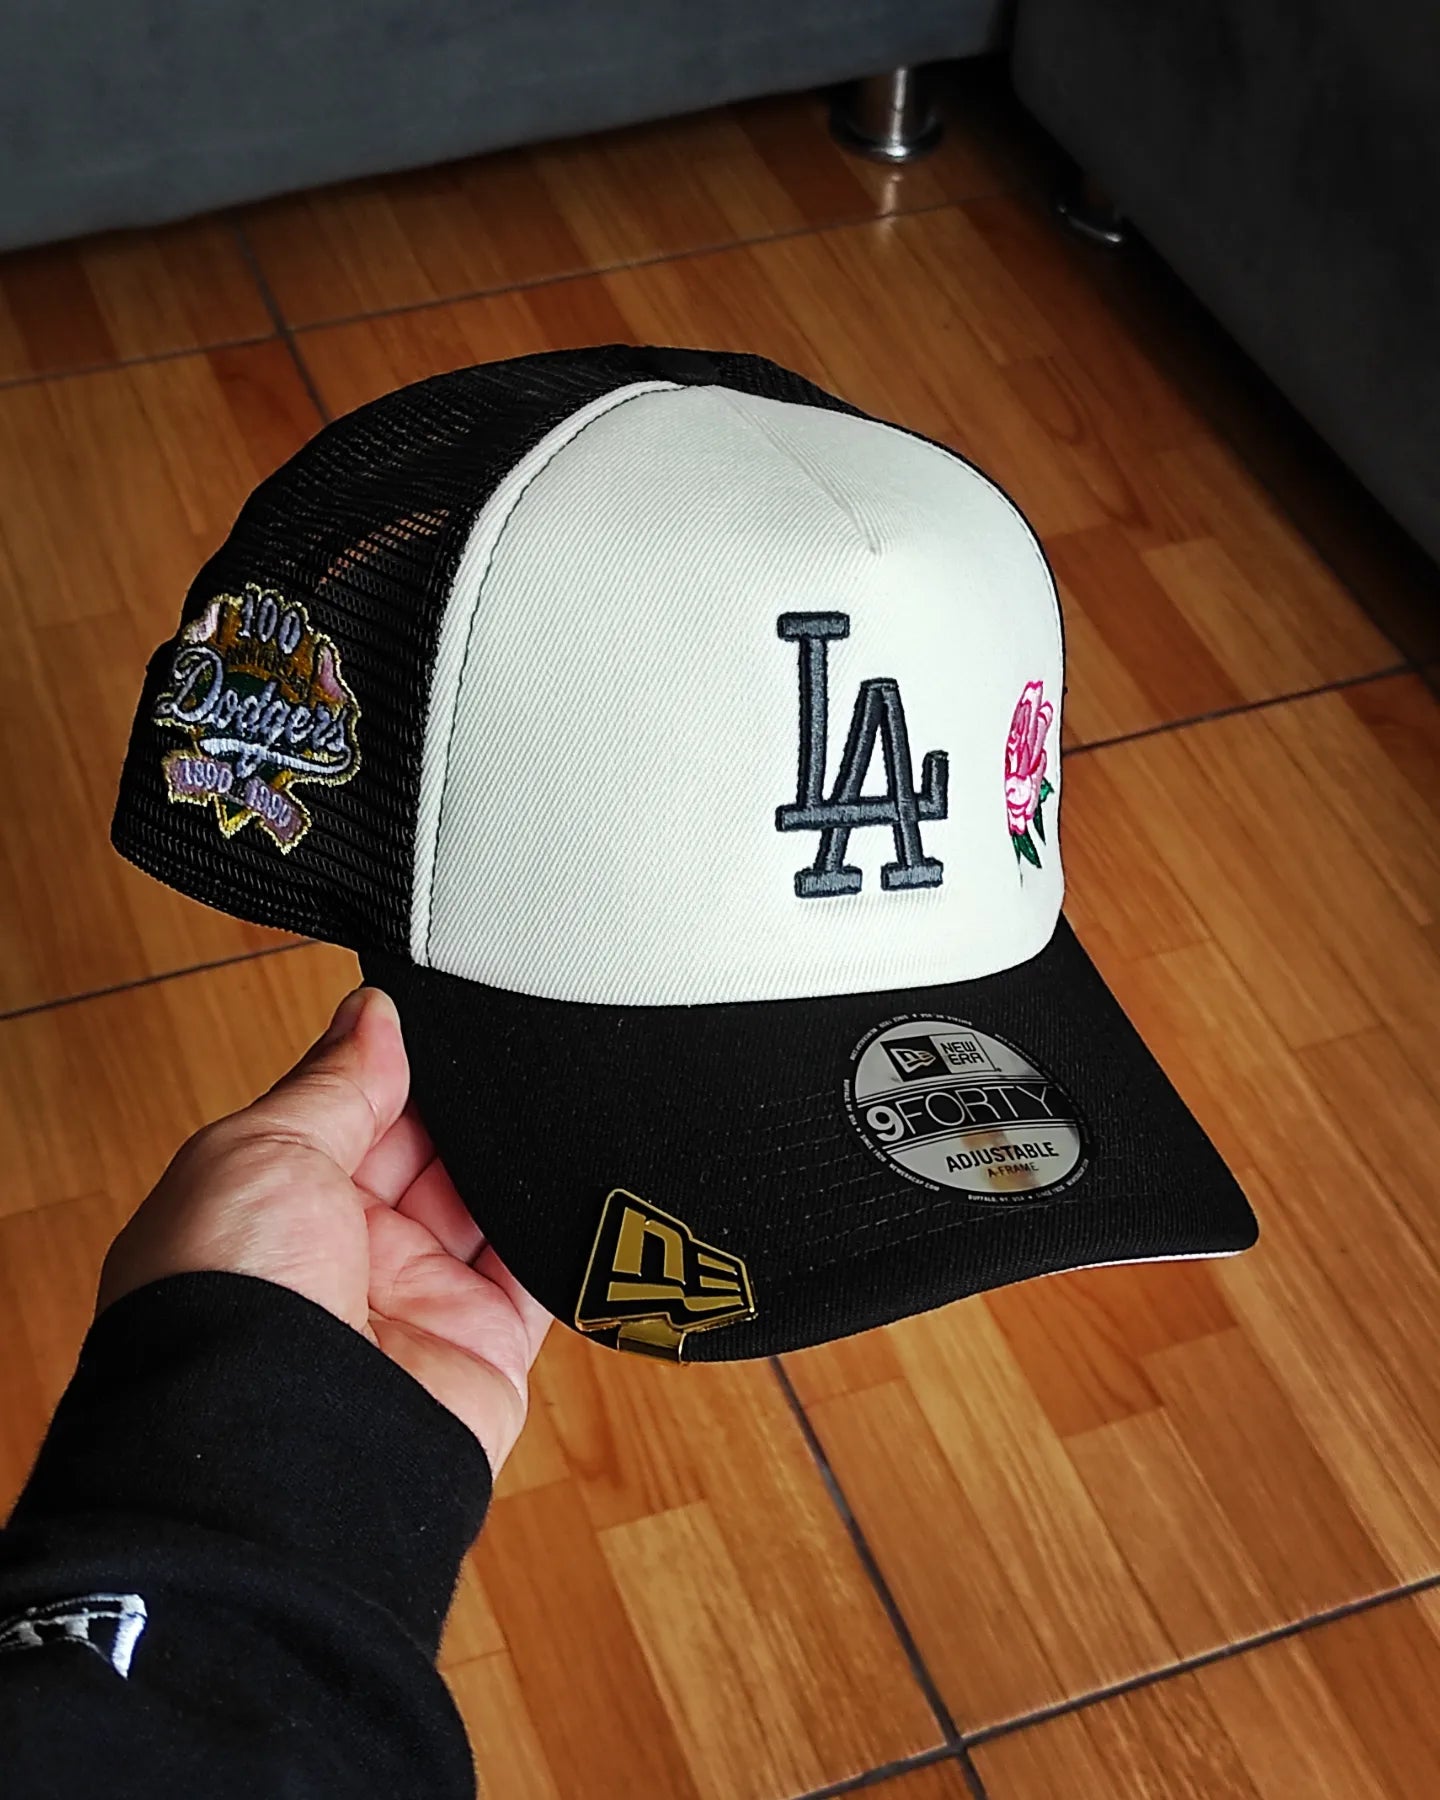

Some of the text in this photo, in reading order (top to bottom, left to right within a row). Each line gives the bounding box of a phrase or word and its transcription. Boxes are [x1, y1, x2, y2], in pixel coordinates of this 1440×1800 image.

[156, 646, 350, 779] Dodgers
[775, 611, 949, 898] LA
[940, 1041, 977, 1055] NEW
[947, 1052, 985, 1066] ERA
[866, 1086, 1054, 1142] 9FORTY
[945, 1142, 1060, 1174] ADJUSTABLE
[987, 1162, 1040, 1178] A-FRAME
